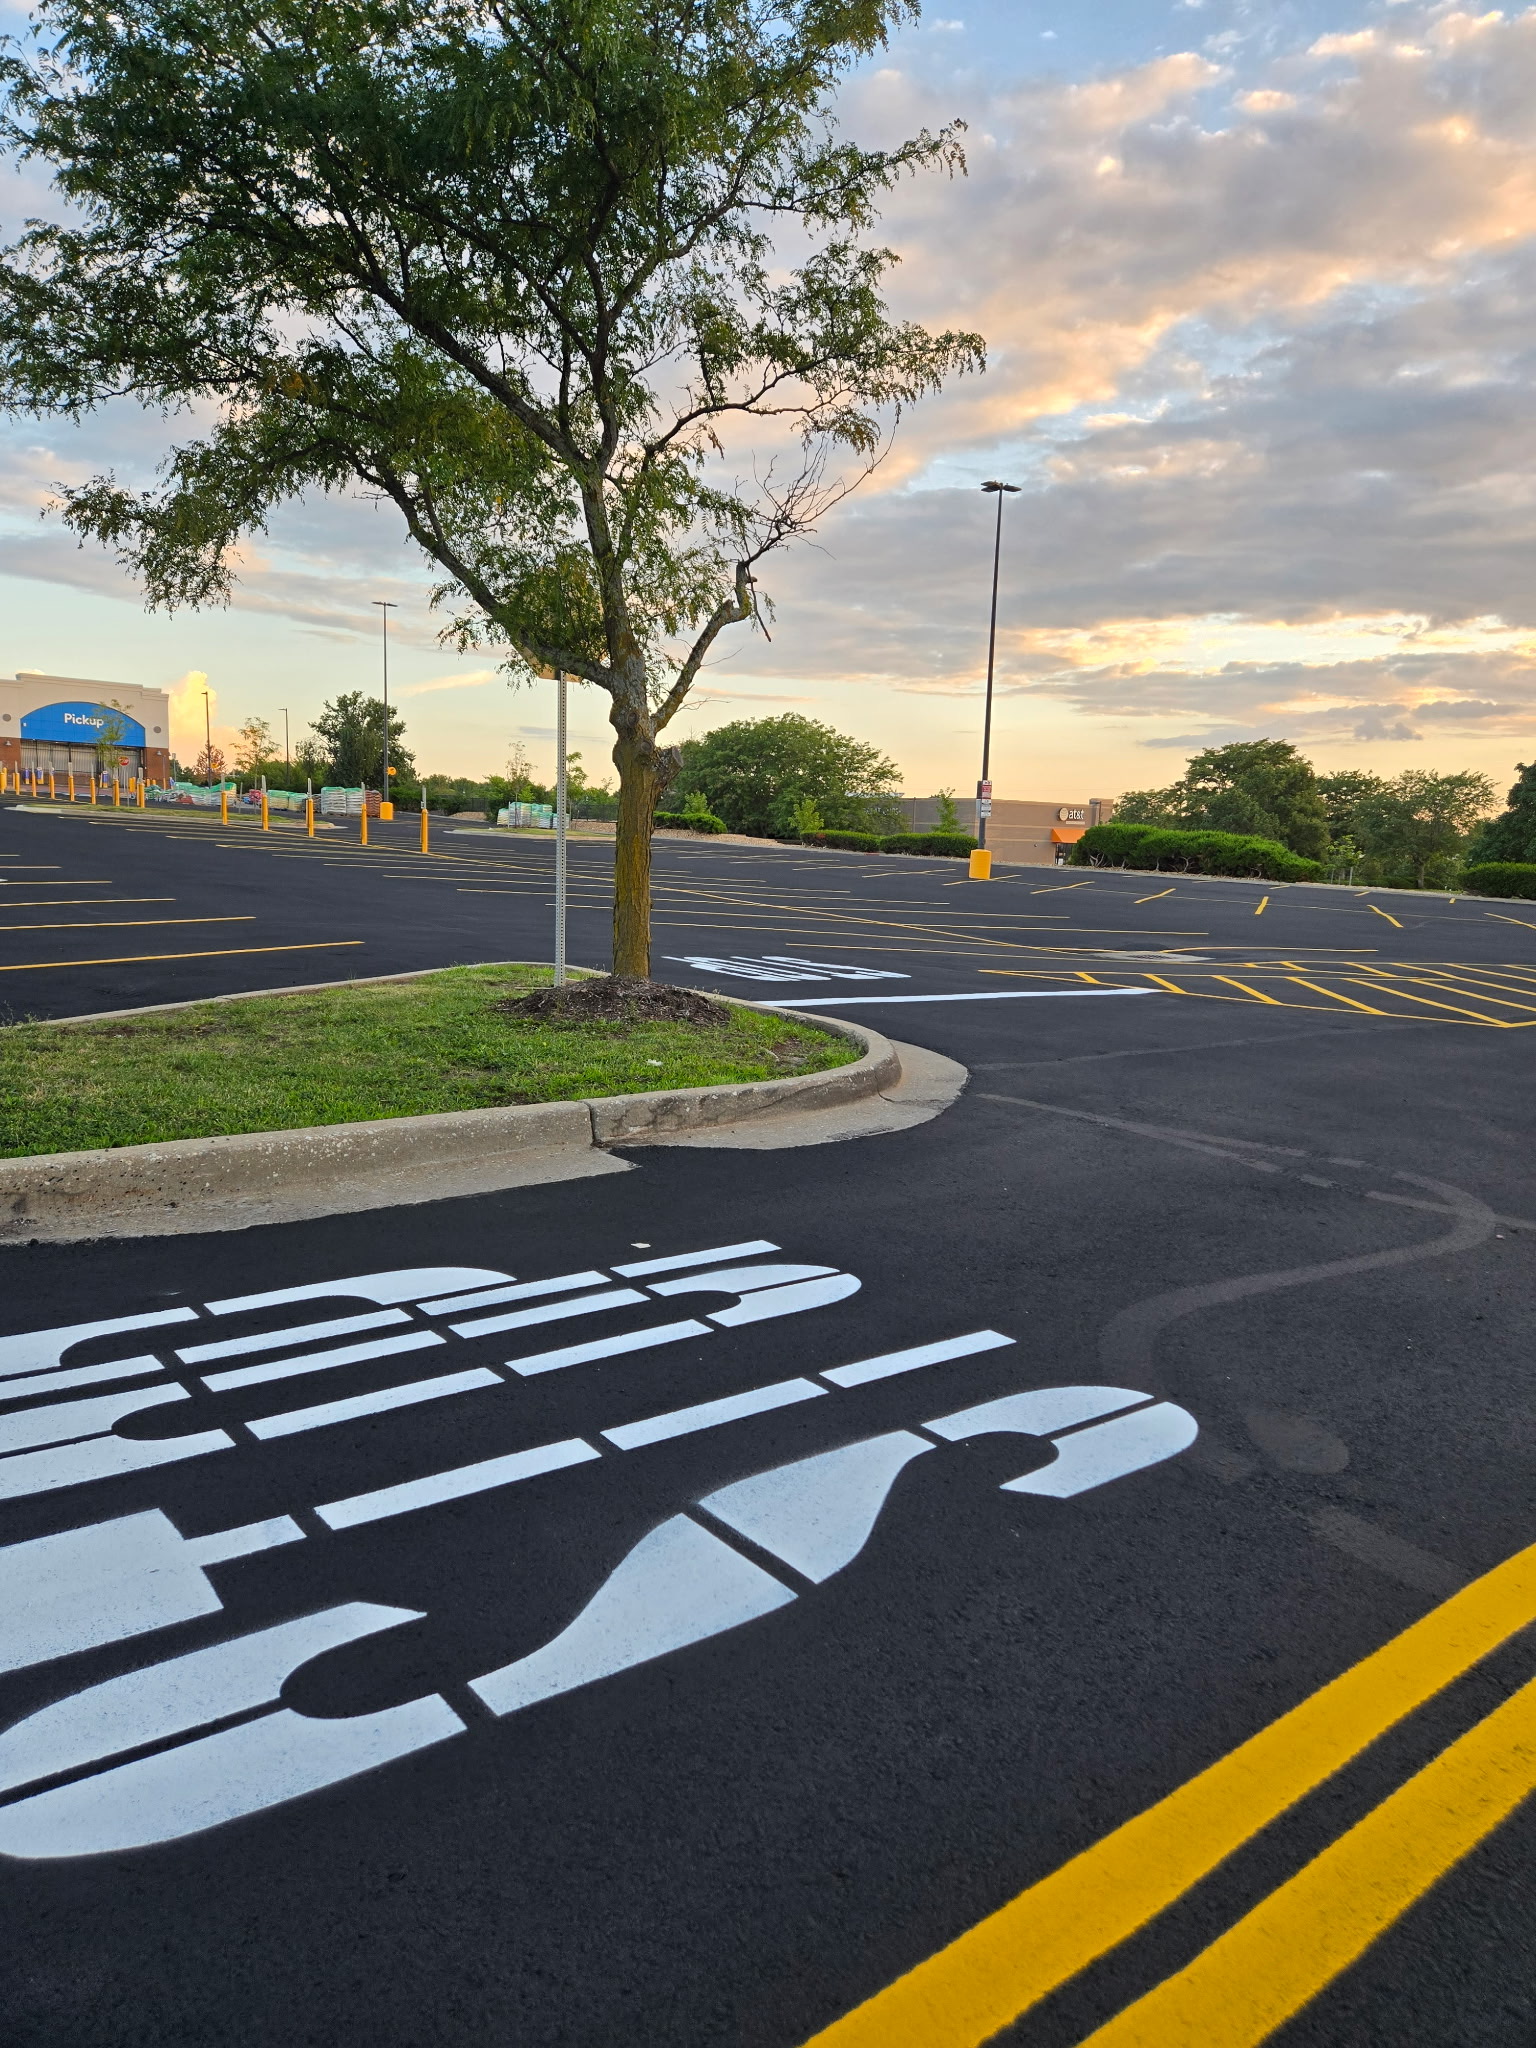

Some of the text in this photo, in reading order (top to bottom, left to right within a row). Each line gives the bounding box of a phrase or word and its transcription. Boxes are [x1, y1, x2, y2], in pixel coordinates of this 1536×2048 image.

[64, 713, 104, 728] Pickup
[660, 955, 912, 982] STOP
[0, 1239, 1199, 1859] STOP
